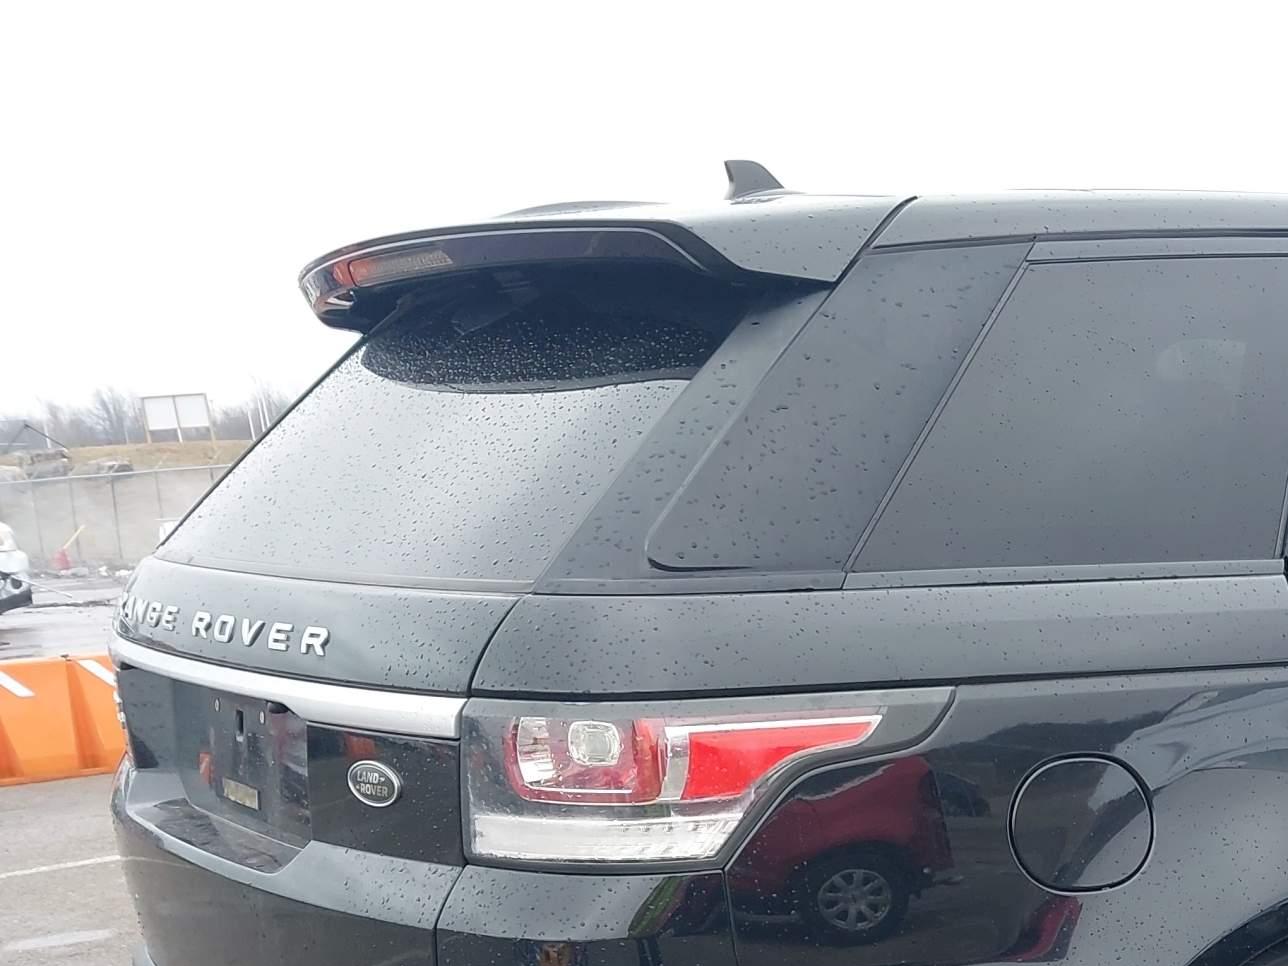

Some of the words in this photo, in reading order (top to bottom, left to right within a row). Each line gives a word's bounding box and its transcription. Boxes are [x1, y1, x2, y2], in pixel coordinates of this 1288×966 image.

[191, 610, 330, 657] ROVER
[356, 770, 380, 784] LAND
[360, 782, 389, 798] ROVER
